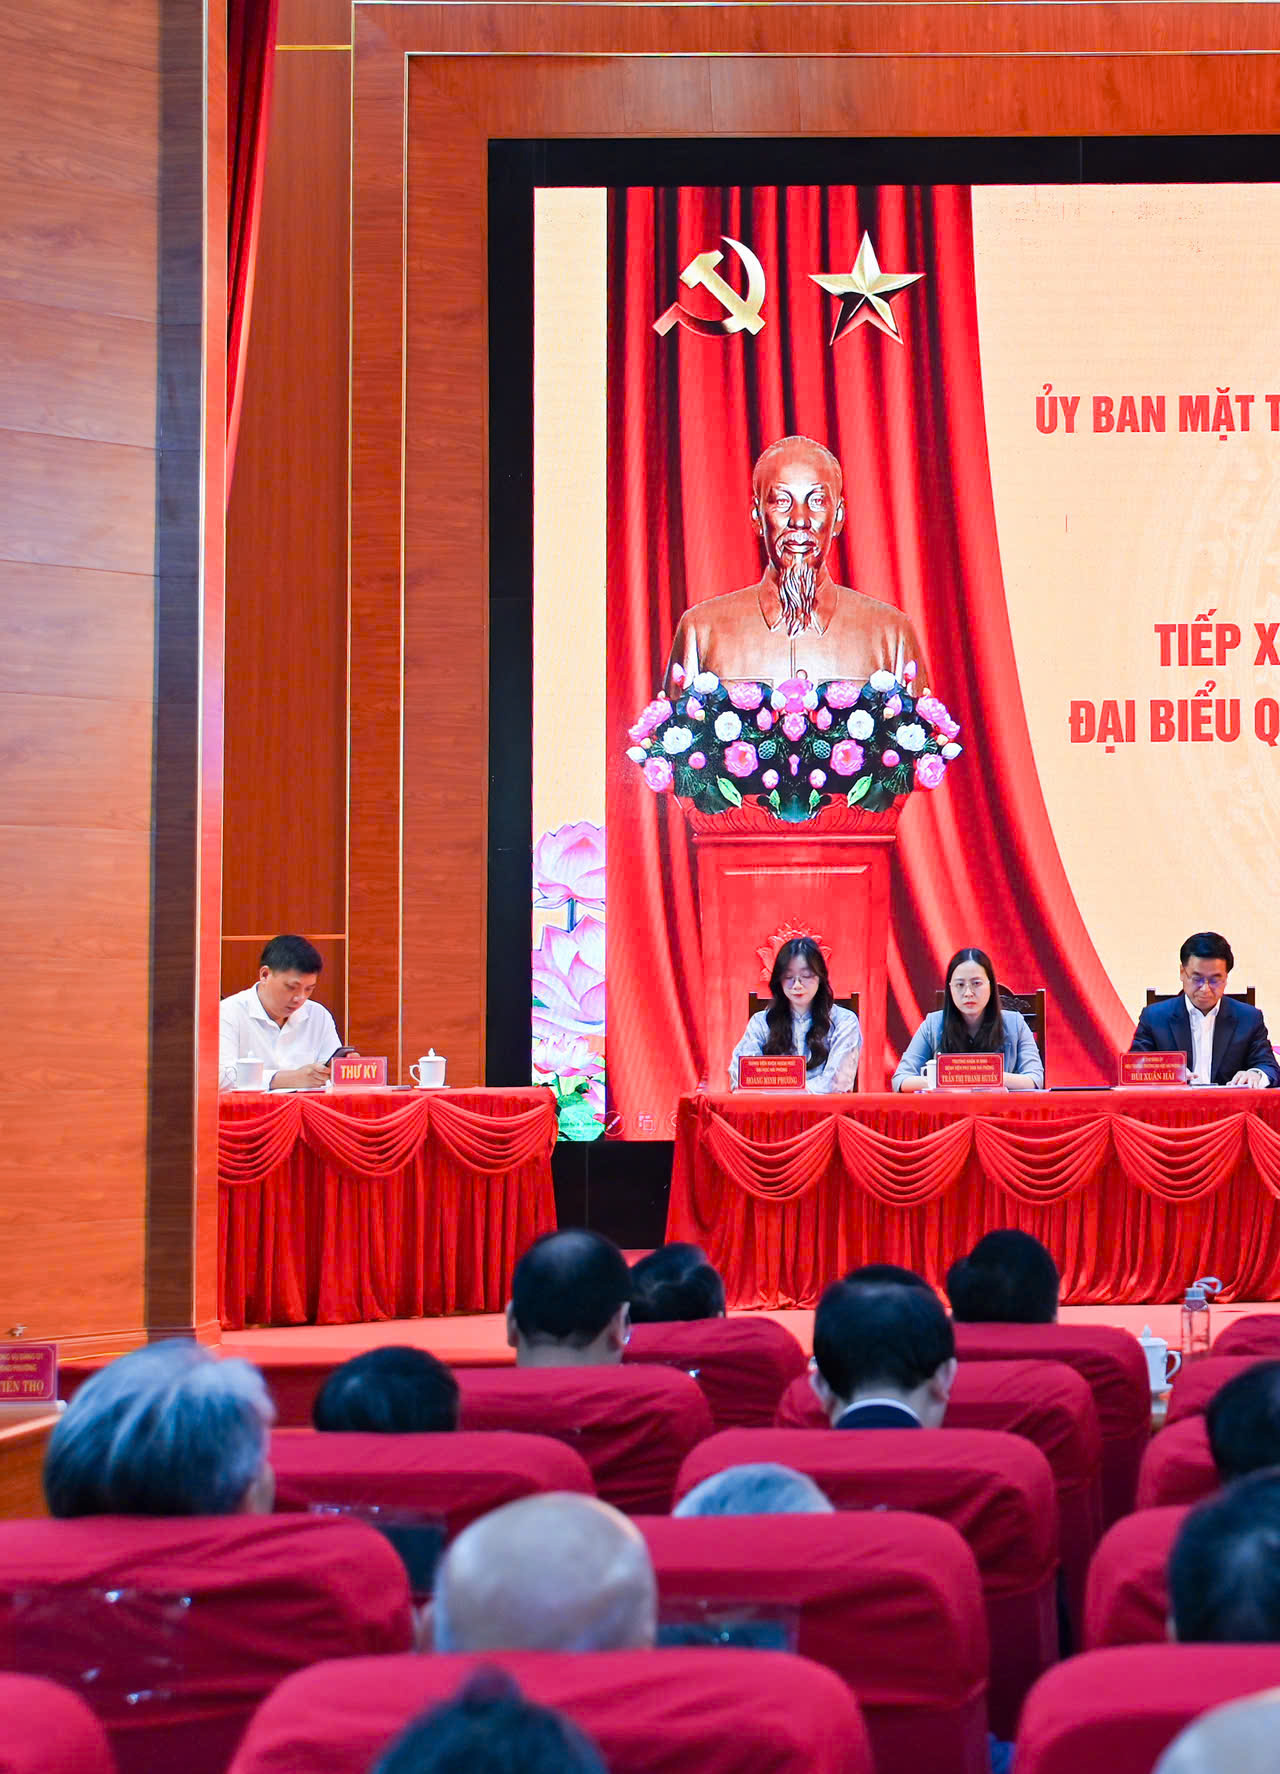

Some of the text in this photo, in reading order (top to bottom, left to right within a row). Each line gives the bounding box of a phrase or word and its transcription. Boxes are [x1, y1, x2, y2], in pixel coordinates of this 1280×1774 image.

[1036, 384, 1080, 434] ỦY
[1093, 396, 1165, 432] BAN
[1179, 387, 1254, 440] MẶT
[1155, 609, 1241, 666] TIẾP
[1069, 700, 1135, 753] ĐẠI
[1151, 681, 1240, 742] BIỂU
[340, 1063, 362, 1079] THƯ
